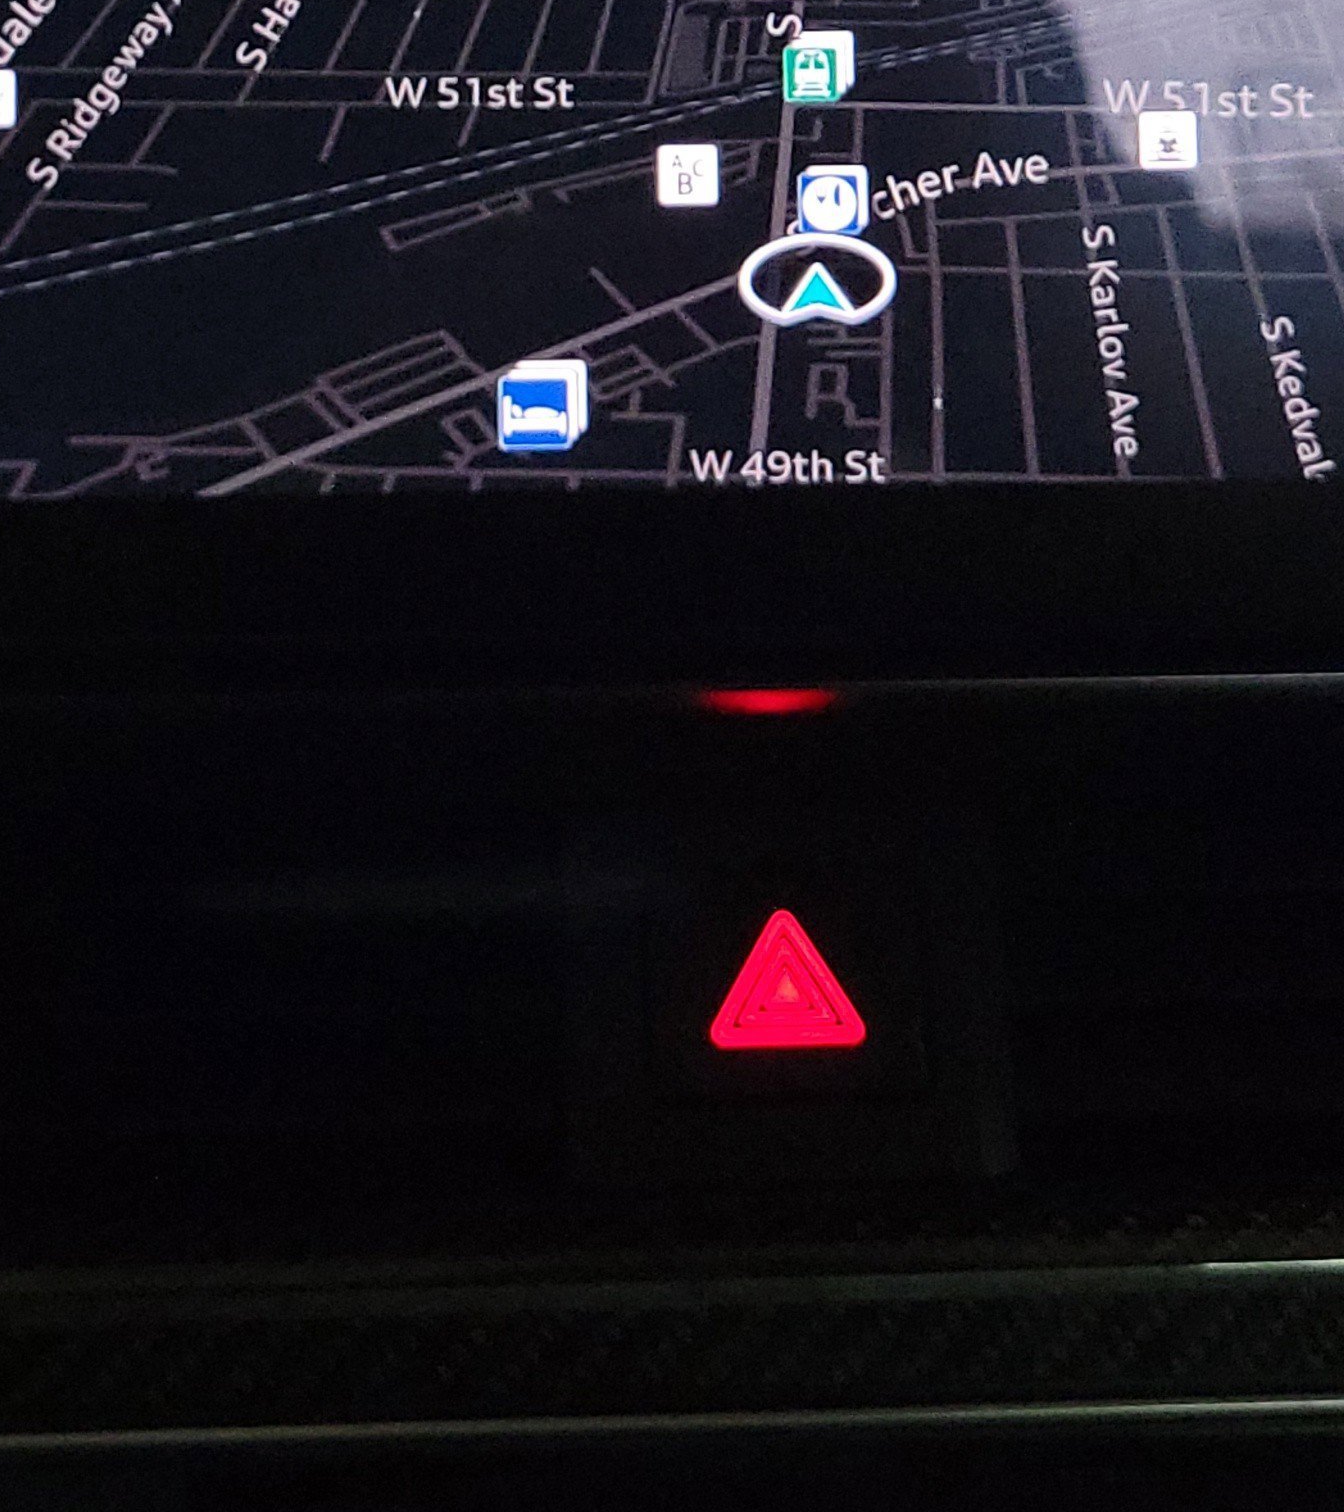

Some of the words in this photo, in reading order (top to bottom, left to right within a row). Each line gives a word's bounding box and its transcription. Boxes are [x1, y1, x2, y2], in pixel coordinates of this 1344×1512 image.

[766, 11, 803, 38] S
[235, 40, 268, 73] S
[26, 156, 59, 189] S
[45, 1, 174, 162] Ridgeway
[385, 76, 427, 109] W
[437, 76, 524, 109] 51st
[533, 76, 575, 109] St
[1103, 78, 1151, 113] W
[1268, 82, 1315, 119] St
[971, 151, 1050, 190] Ave
[1081, 224, 1116, 249] S
[1087, 259, 1130, 381] Karlov
[1259, 315, 1296, 343] S
[1105, 388, 1141, 459] Ave
[1269, 348, 1338, 482] Kedval
[688, 448, 733, 483] W
[739, 449, 834, 485] 49th
[844, 449, 886, 485] St
